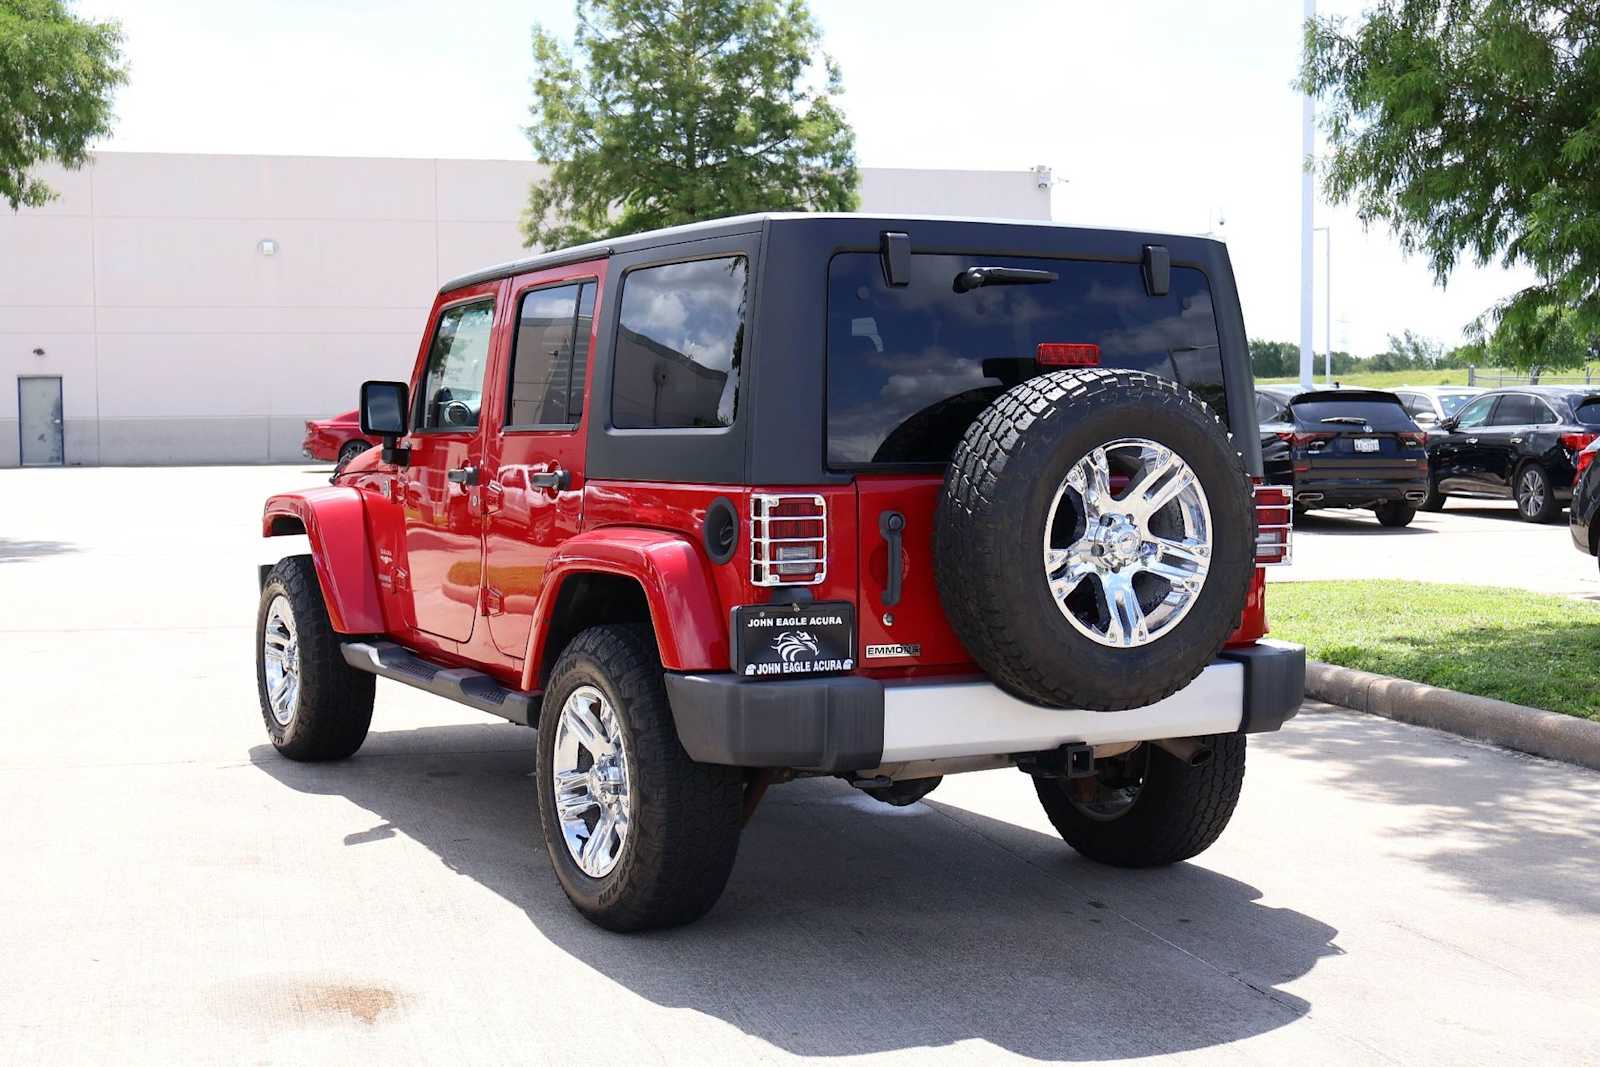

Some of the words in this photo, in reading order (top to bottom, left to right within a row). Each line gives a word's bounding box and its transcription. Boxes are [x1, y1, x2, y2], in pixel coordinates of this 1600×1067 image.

[747, 618, 774, 627] JOHN
[776, 616, 807, 626] EAGLE
[809, 616, 843, 625] ACURA
[757, 663, 781, 675] JOHN
[782, 661, 812, 674] EAGLE
[813, 660, 843, 672] ACURA
